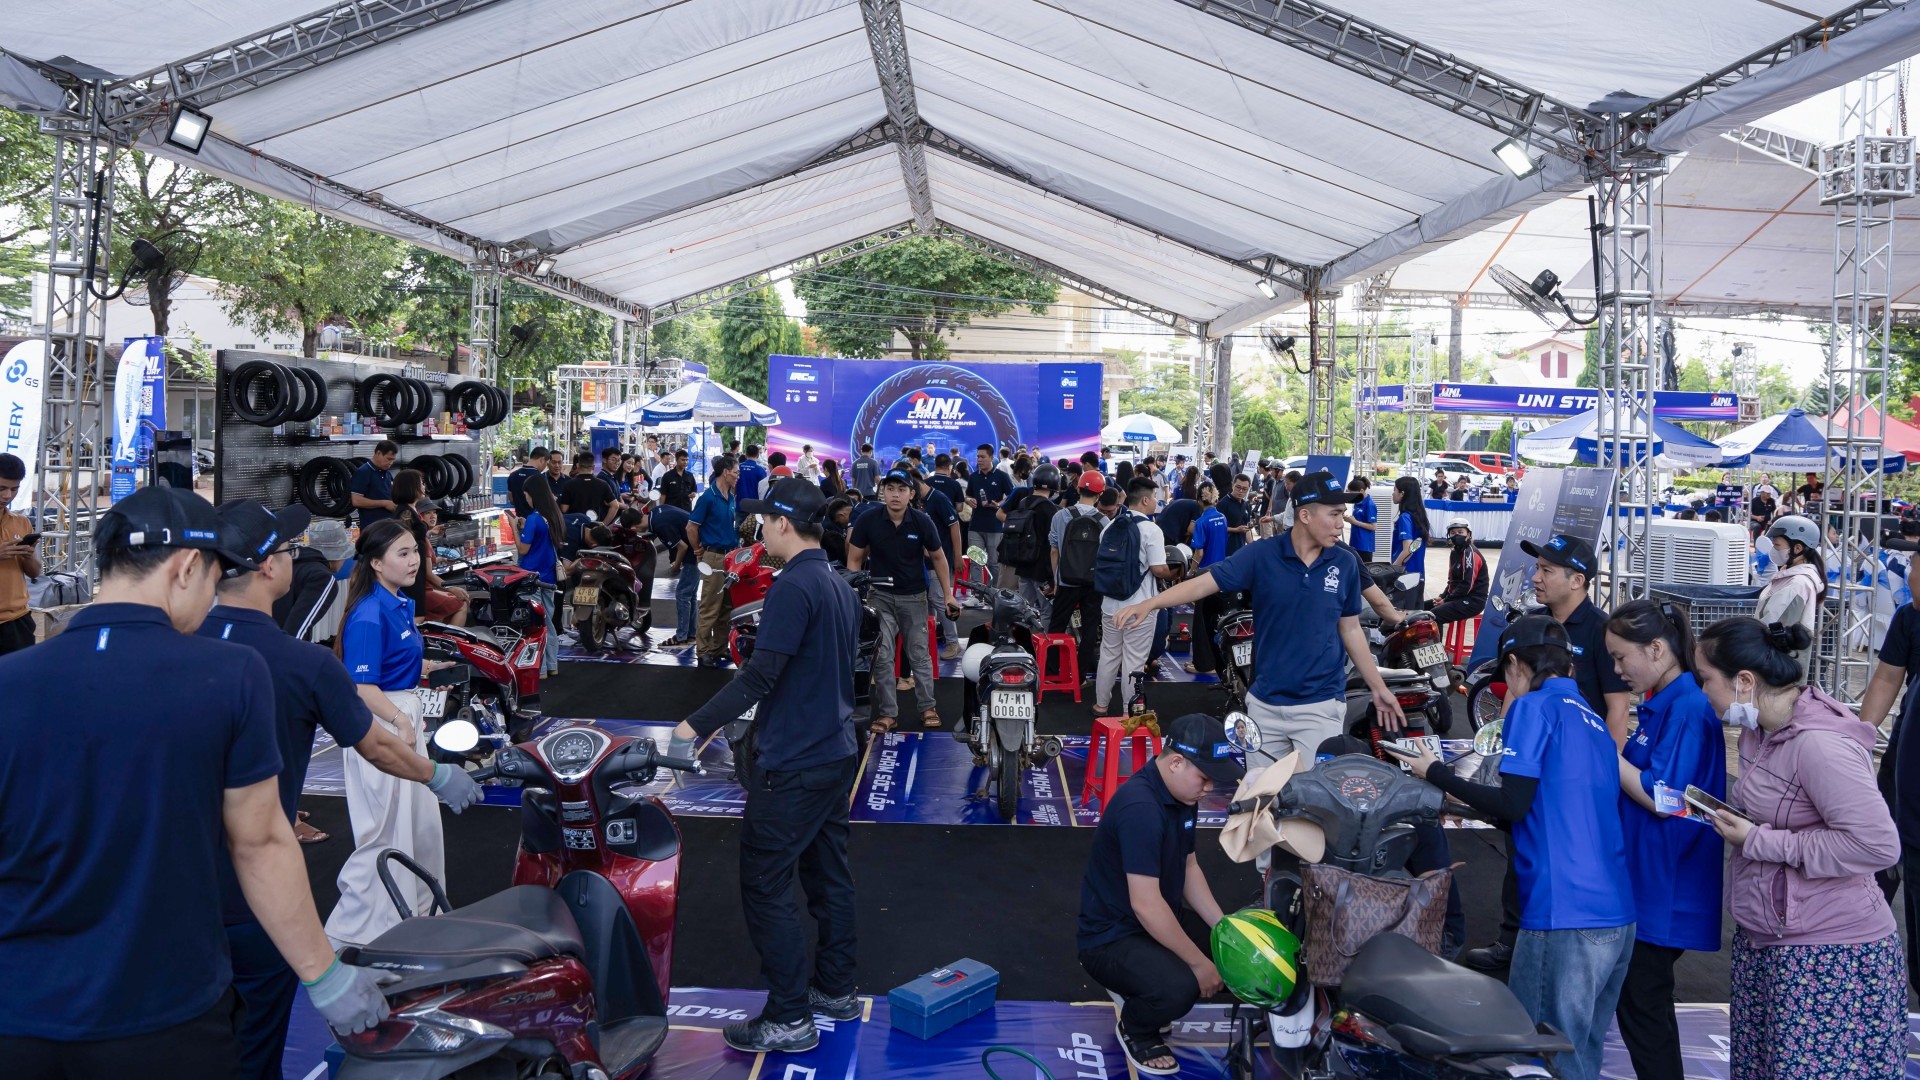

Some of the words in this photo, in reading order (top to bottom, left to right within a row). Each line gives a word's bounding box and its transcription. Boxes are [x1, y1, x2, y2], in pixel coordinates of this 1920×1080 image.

[145, 356, 159, 368] NI
[24, 377, 39, 388] GS
[914, 397, 962, 413] UNI
[1517, 394, 1555, 408] UNI
[907, 411, 940, 420] CARE
[941, 412, 966, 420] DAY
[6, 401, 25, 452] TERY
[1767, 442, 1809, 452] IRC
[1537, 503, 1546, 512] GS
[1516, 523, 1529, 538] ẮC
[1529, 527, 1543, 540] QUY
[1418, 651, 1447, 668] 140.52
[416, 690, 440, 702] 7-F1
[998, 693, 1027, 705] 47-M1
[994, 706, 1031, 718] 008.60
[877, 749, 900, 774] CHĂM
[871, 773, 896, 792] SÓC
[1027, 772, 1053, 799] CHĂM
[866, 792, 896, 811] LỐP
[1057, 1032, 1109, 1080] LỐP
